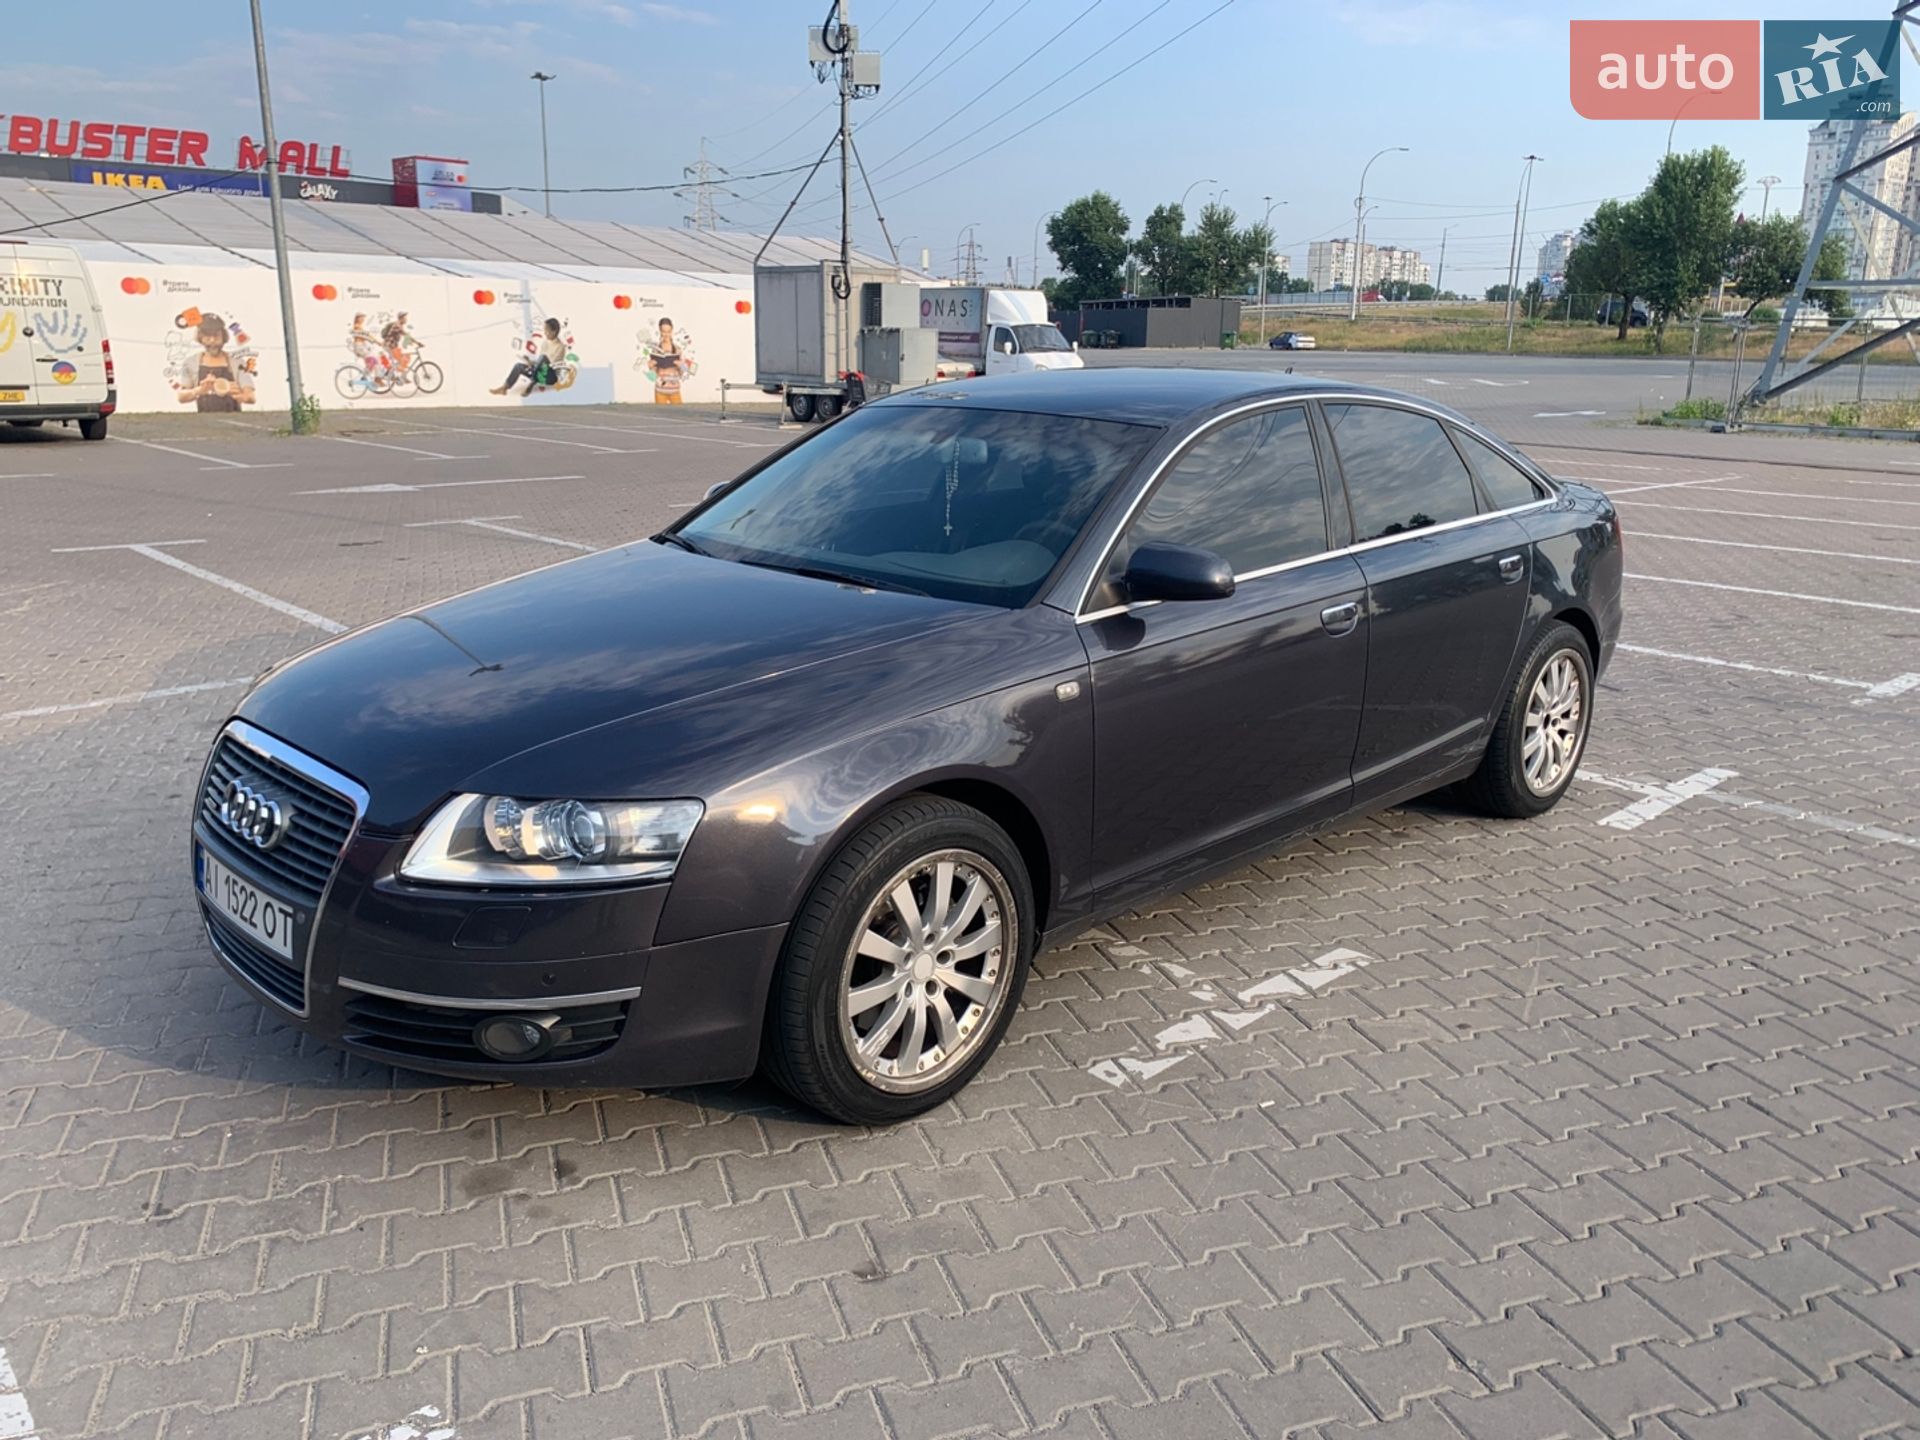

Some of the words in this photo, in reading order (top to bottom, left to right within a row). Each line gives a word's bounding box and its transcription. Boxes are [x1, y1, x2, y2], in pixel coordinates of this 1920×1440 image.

[0, 114, 209, 167] BUSTER
[92, 171, 167, 190] IKEA
[224, 874, 258, 930] 1522
[263, 901, 294, 948] OT
